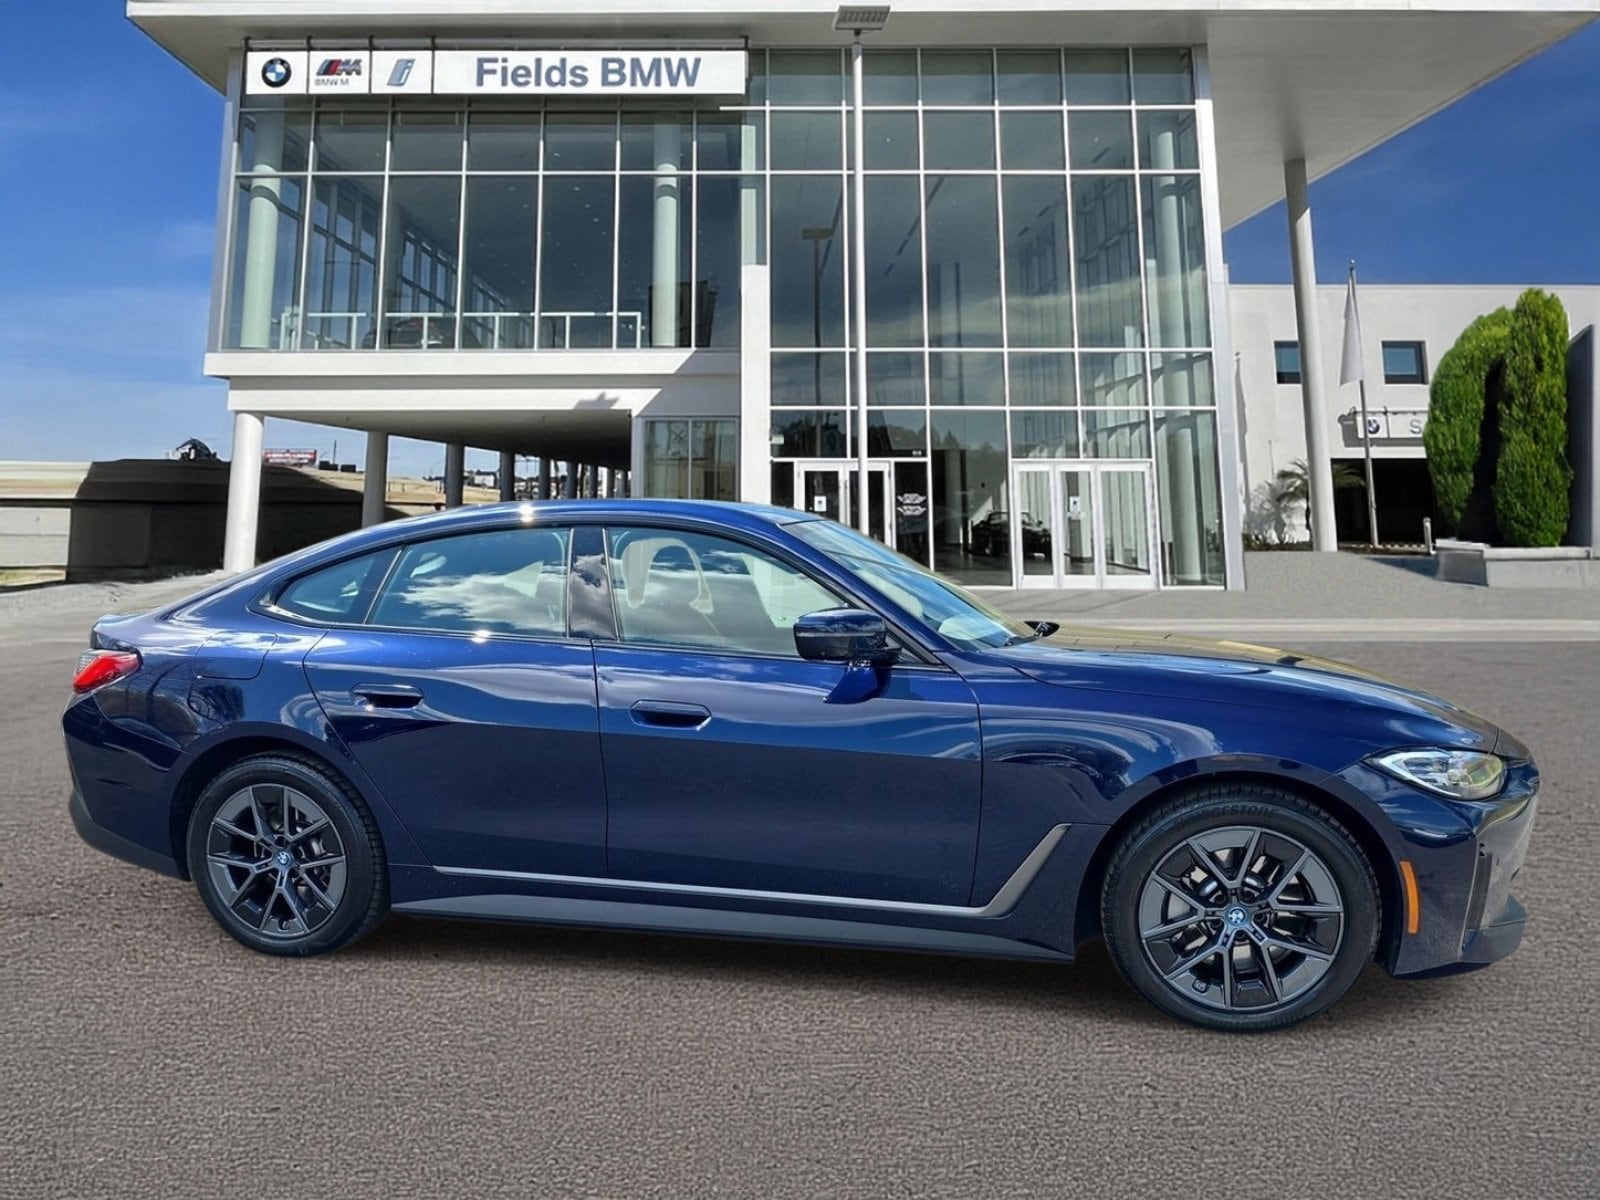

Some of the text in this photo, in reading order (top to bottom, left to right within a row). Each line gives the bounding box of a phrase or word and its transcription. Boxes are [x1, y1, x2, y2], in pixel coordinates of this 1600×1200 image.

[476, 57, 701, 87] Fields BMW
[314, 78, 339, 86] BMW
